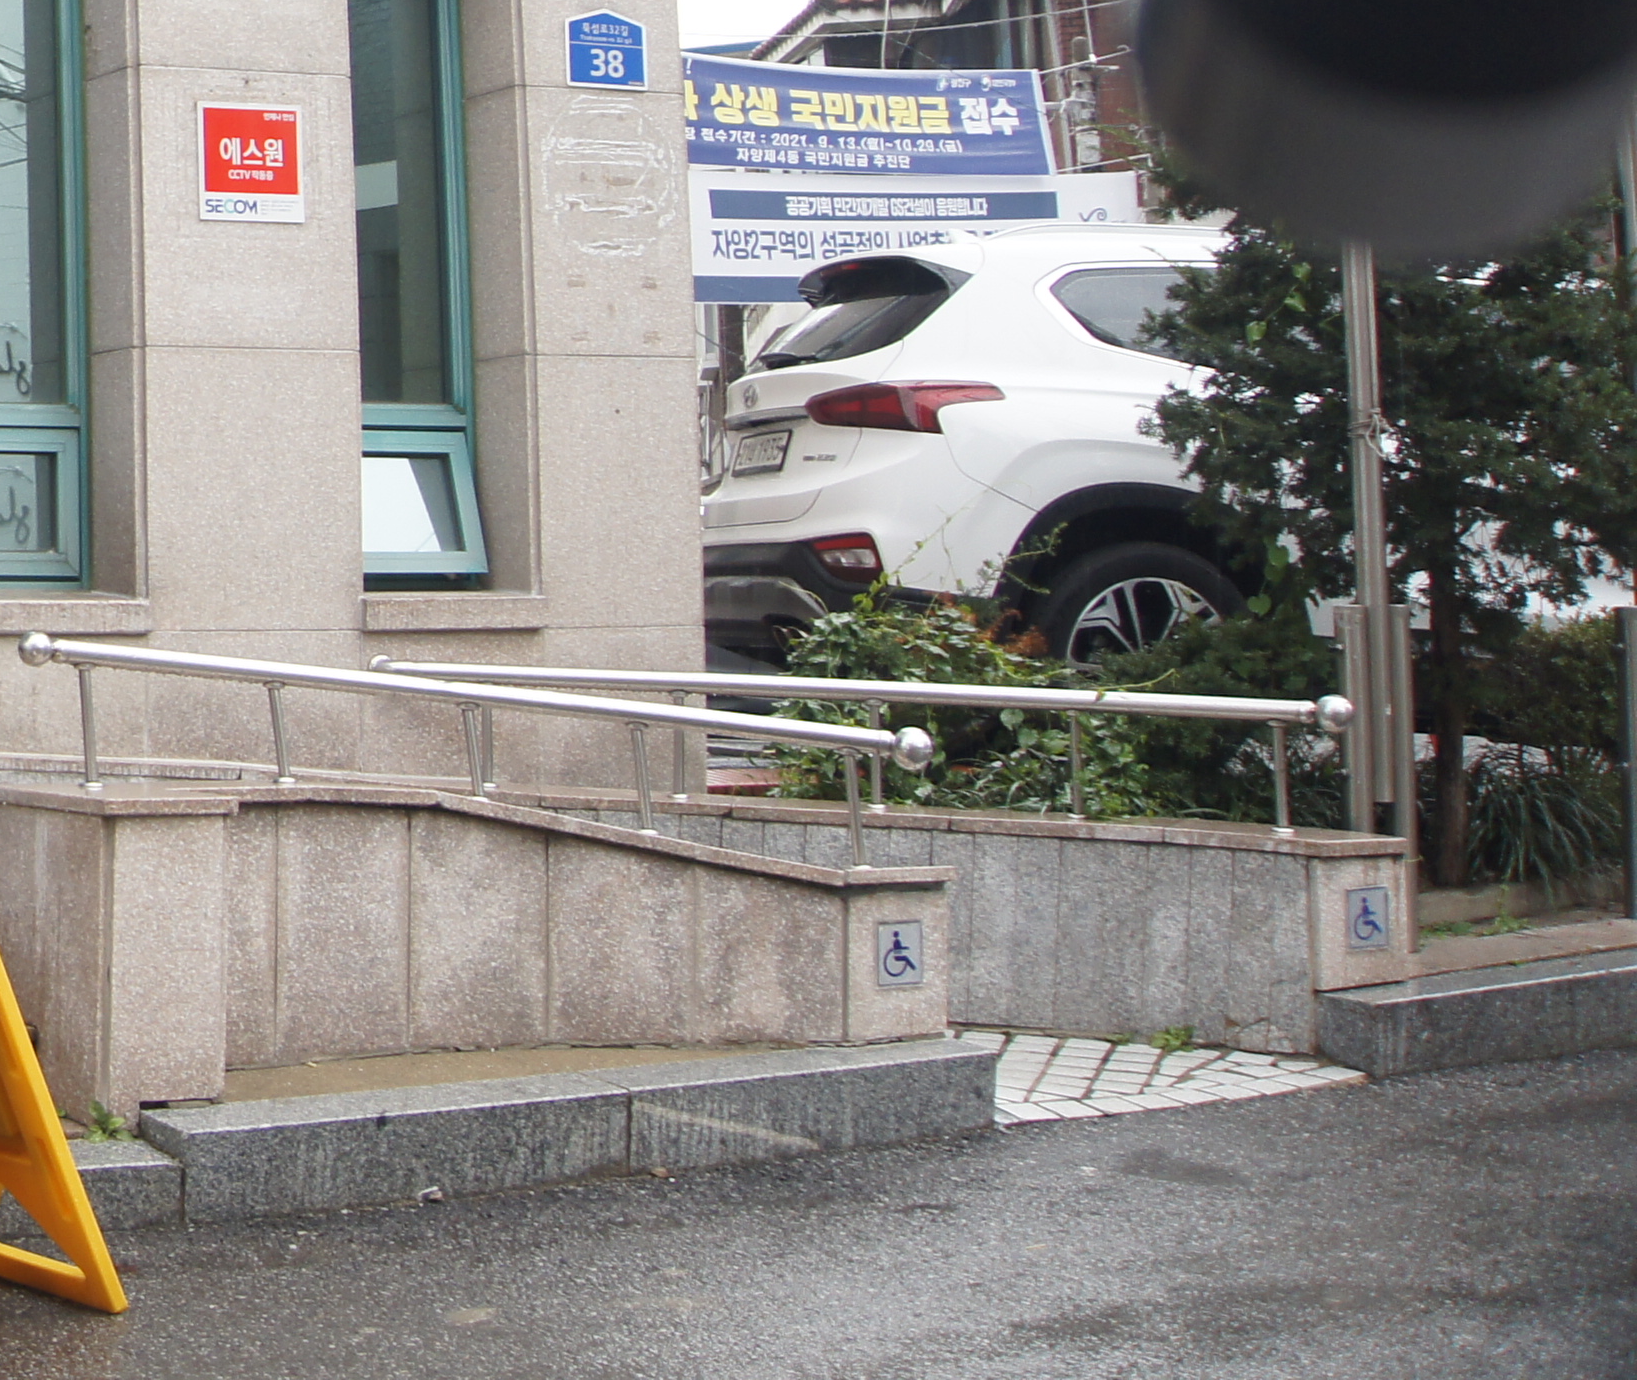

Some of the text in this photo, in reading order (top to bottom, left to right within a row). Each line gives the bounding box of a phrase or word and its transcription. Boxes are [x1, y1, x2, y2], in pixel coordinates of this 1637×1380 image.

[590, 48, 625, 78] 38
[710, 81, 780, 127] 상생
[788, 87, 953, 134] 국민지원금
[958, 96, 1020, 136] 접수
[700, 128, 756, 144] 접수기간
[770, 133, 814, 148] 2021.
[219, 137, 284, 167] 에스원
[736, 147, 911, 169] 자양제4동 국민지원금 추진단
[228, 169, 274, 181] CCTV 작동중
[205, 199, 258, 215] SECOM
[785, 196, 833, 216] 공공기획
[710, 229, 816, 261] 자양2구역의
